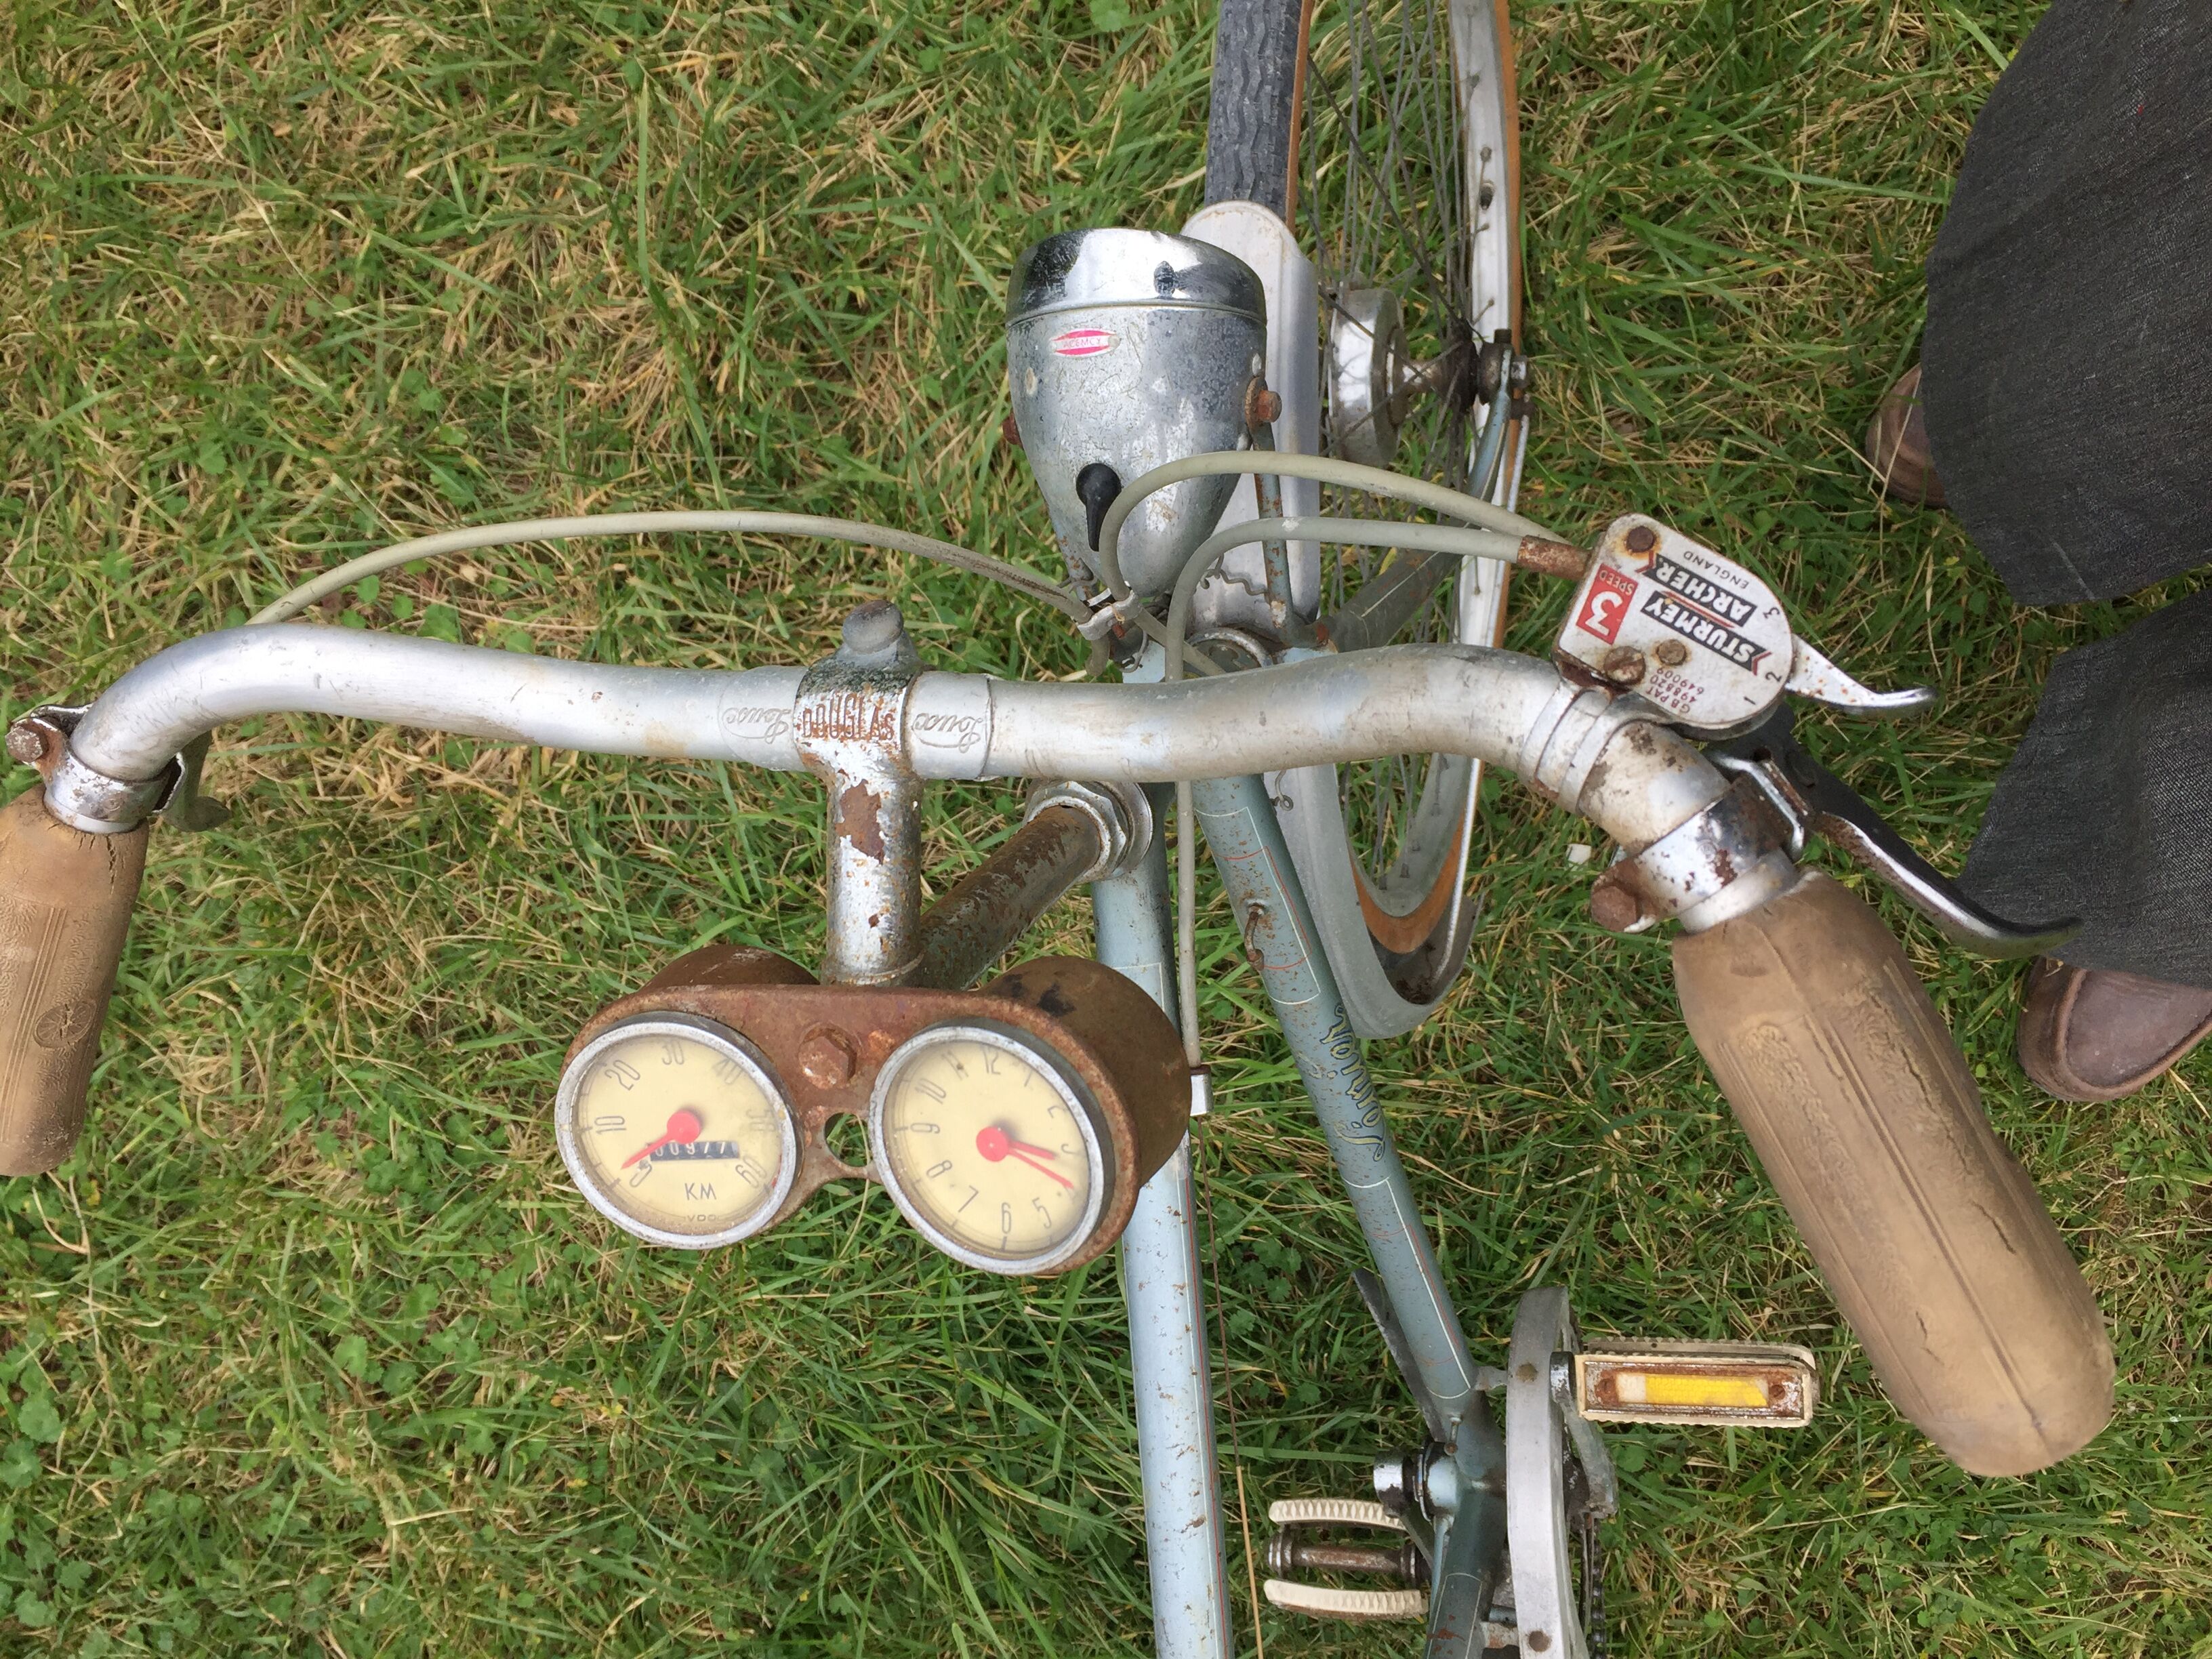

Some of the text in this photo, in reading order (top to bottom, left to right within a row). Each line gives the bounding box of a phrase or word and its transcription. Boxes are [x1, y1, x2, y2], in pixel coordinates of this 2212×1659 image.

[1599, 569, 1635, 596] SPEED
[1683, 550, 1750, 590] ENGLAND
[1584, 590, 1624, 637] 3
[1763, 607, 1780, 619] 3
[1645, 597, 1755, 663] STURMEY
[1649, 674, 1698, 703] 498820
[1656, 668, 1704, 695] 649009
[1765, 671, 1782, 682] 2
[802, 691, 895, 741] DOUGLAS
[661, 1042, 685, 1066] 30
[982, 1044, 1002, 1076] 12
[604, 1059, 640, 1091] 20
[712, 1055, 744, 1085] 40
[914, 1078, 947, 1105] 10
[594, 1115, 627, 1136] 10
[909, 1122, 941, 1134] 9
[735, 1155, 768, 1188] 60
[926, 1160, 953, 1179] 8
[683, 1181, 717, 1202] KM
[958, 1185, 980, 1213] 7
[1000, 1202, 1012, 1235] 6
[1031, 1197, 1052, 1229] 5
